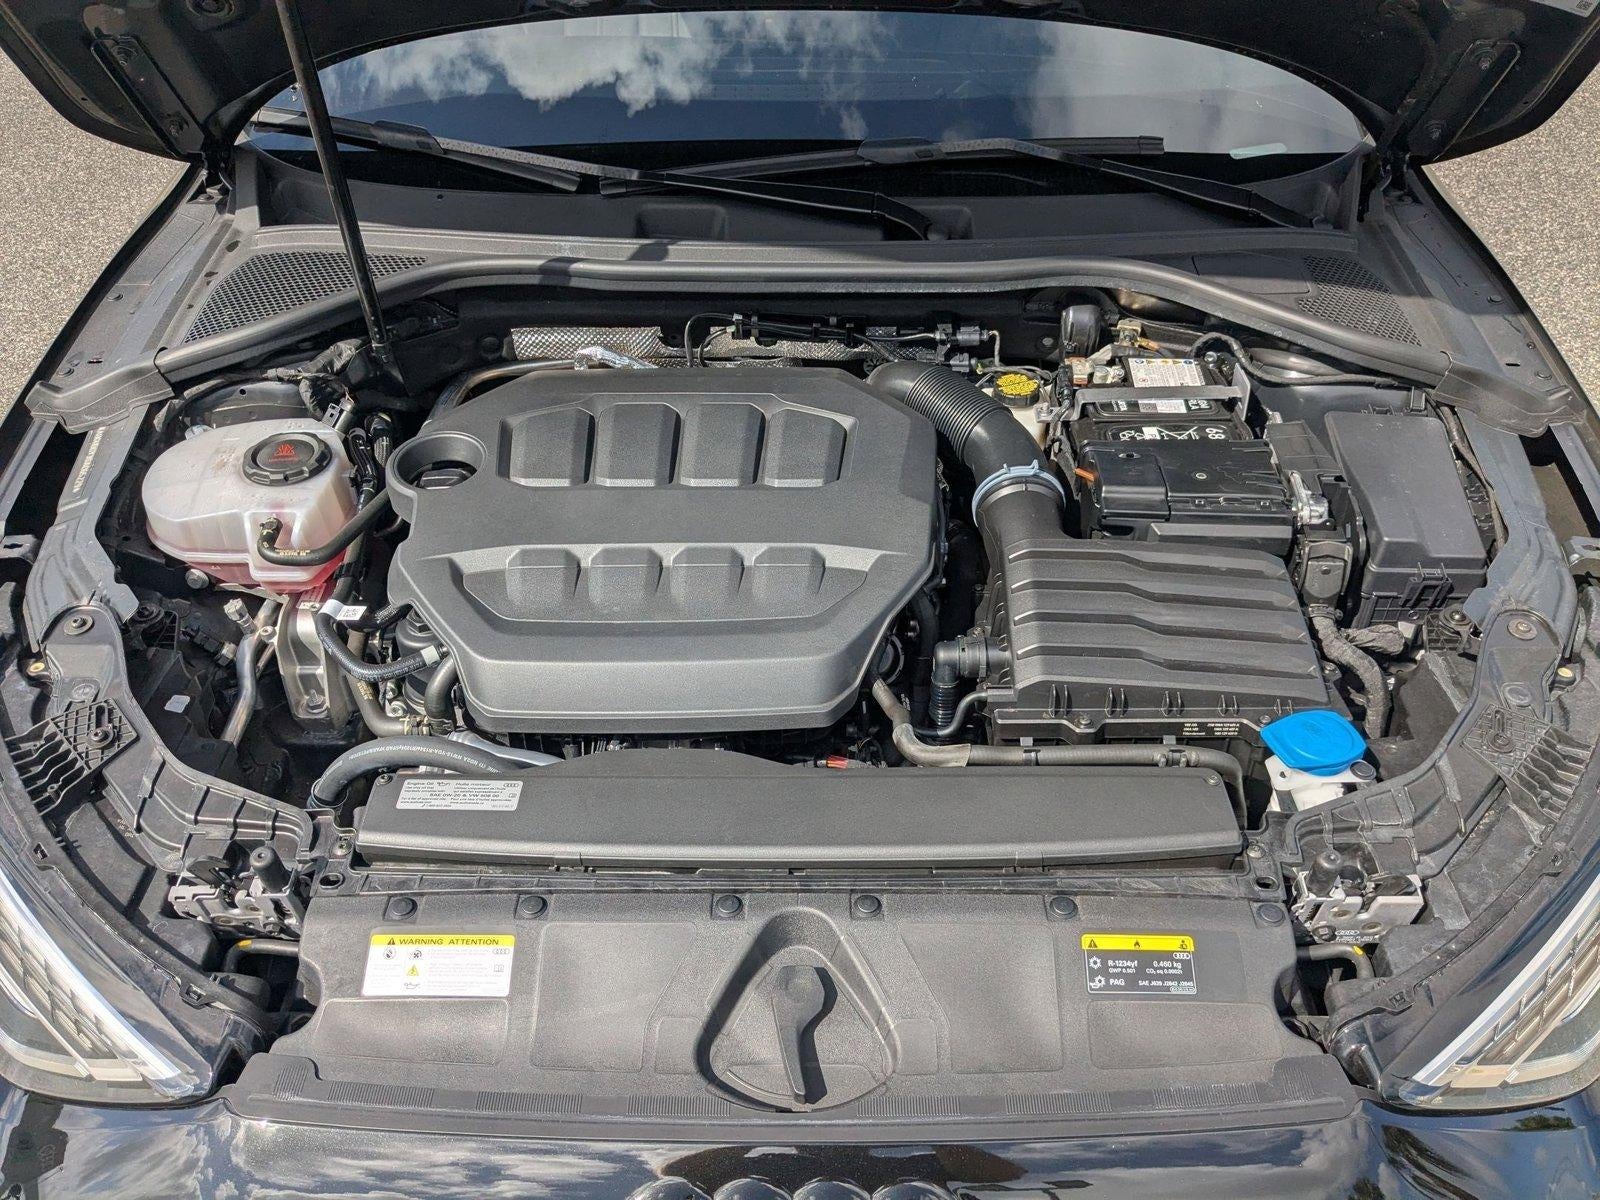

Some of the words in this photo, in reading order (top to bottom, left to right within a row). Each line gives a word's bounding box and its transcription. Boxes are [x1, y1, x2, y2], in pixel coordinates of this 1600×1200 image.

[1107, 959, 1138, 968] R-1234yf
[1173, 960, 1182, 969] kg
[1109, 978, 1125, 986] PAG
